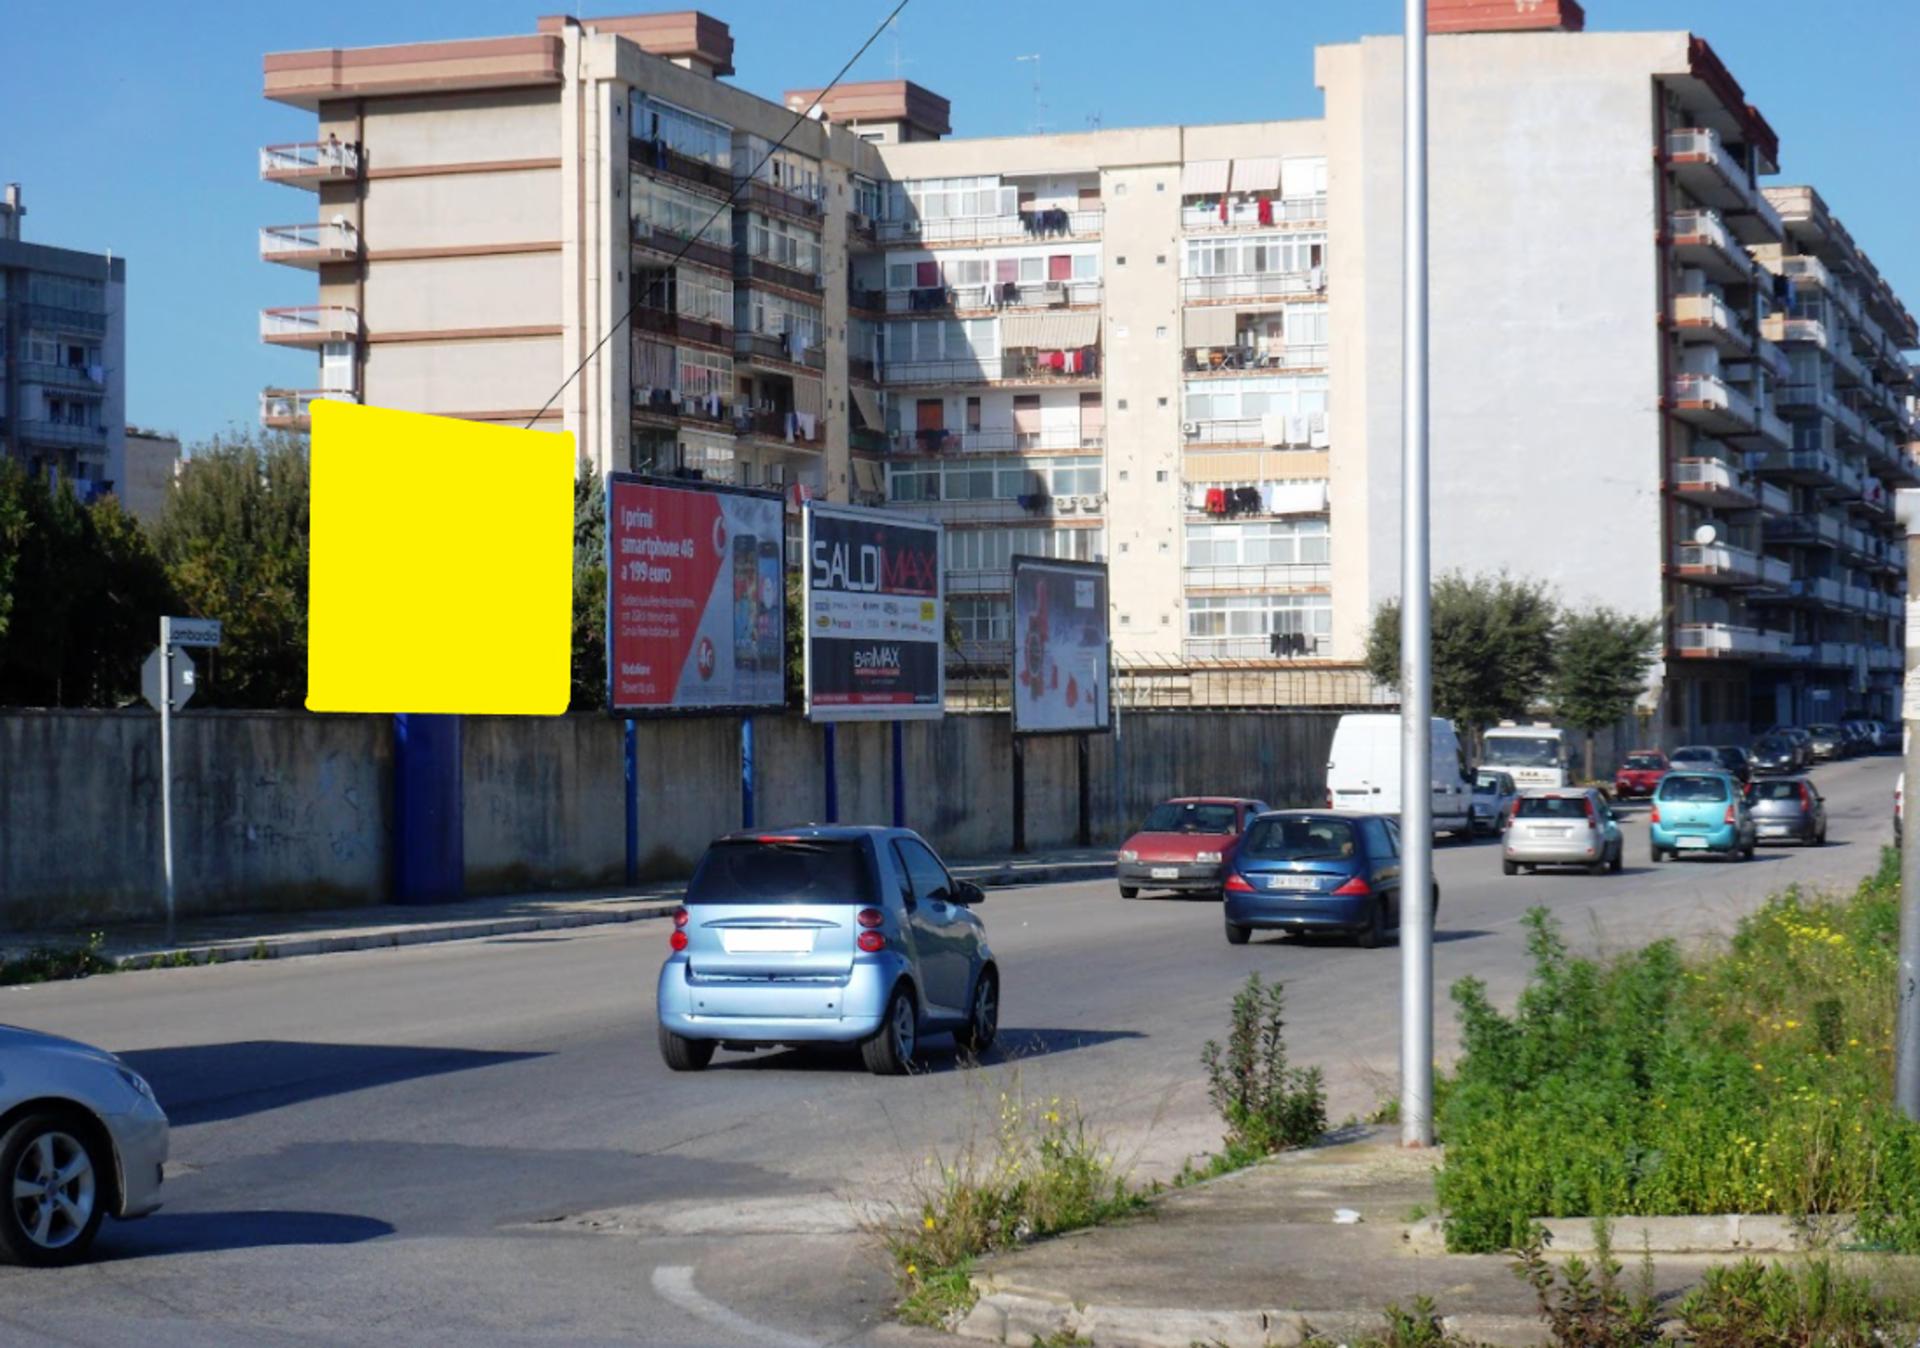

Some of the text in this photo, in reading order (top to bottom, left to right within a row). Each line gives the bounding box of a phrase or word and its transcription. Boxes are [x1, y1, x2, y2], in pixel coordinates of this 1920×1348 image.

[626, 507, 653, 531] primi
[621, 536, 694, 560] smartphone 4G
[621, 561, 672, 584] a 199 euro
